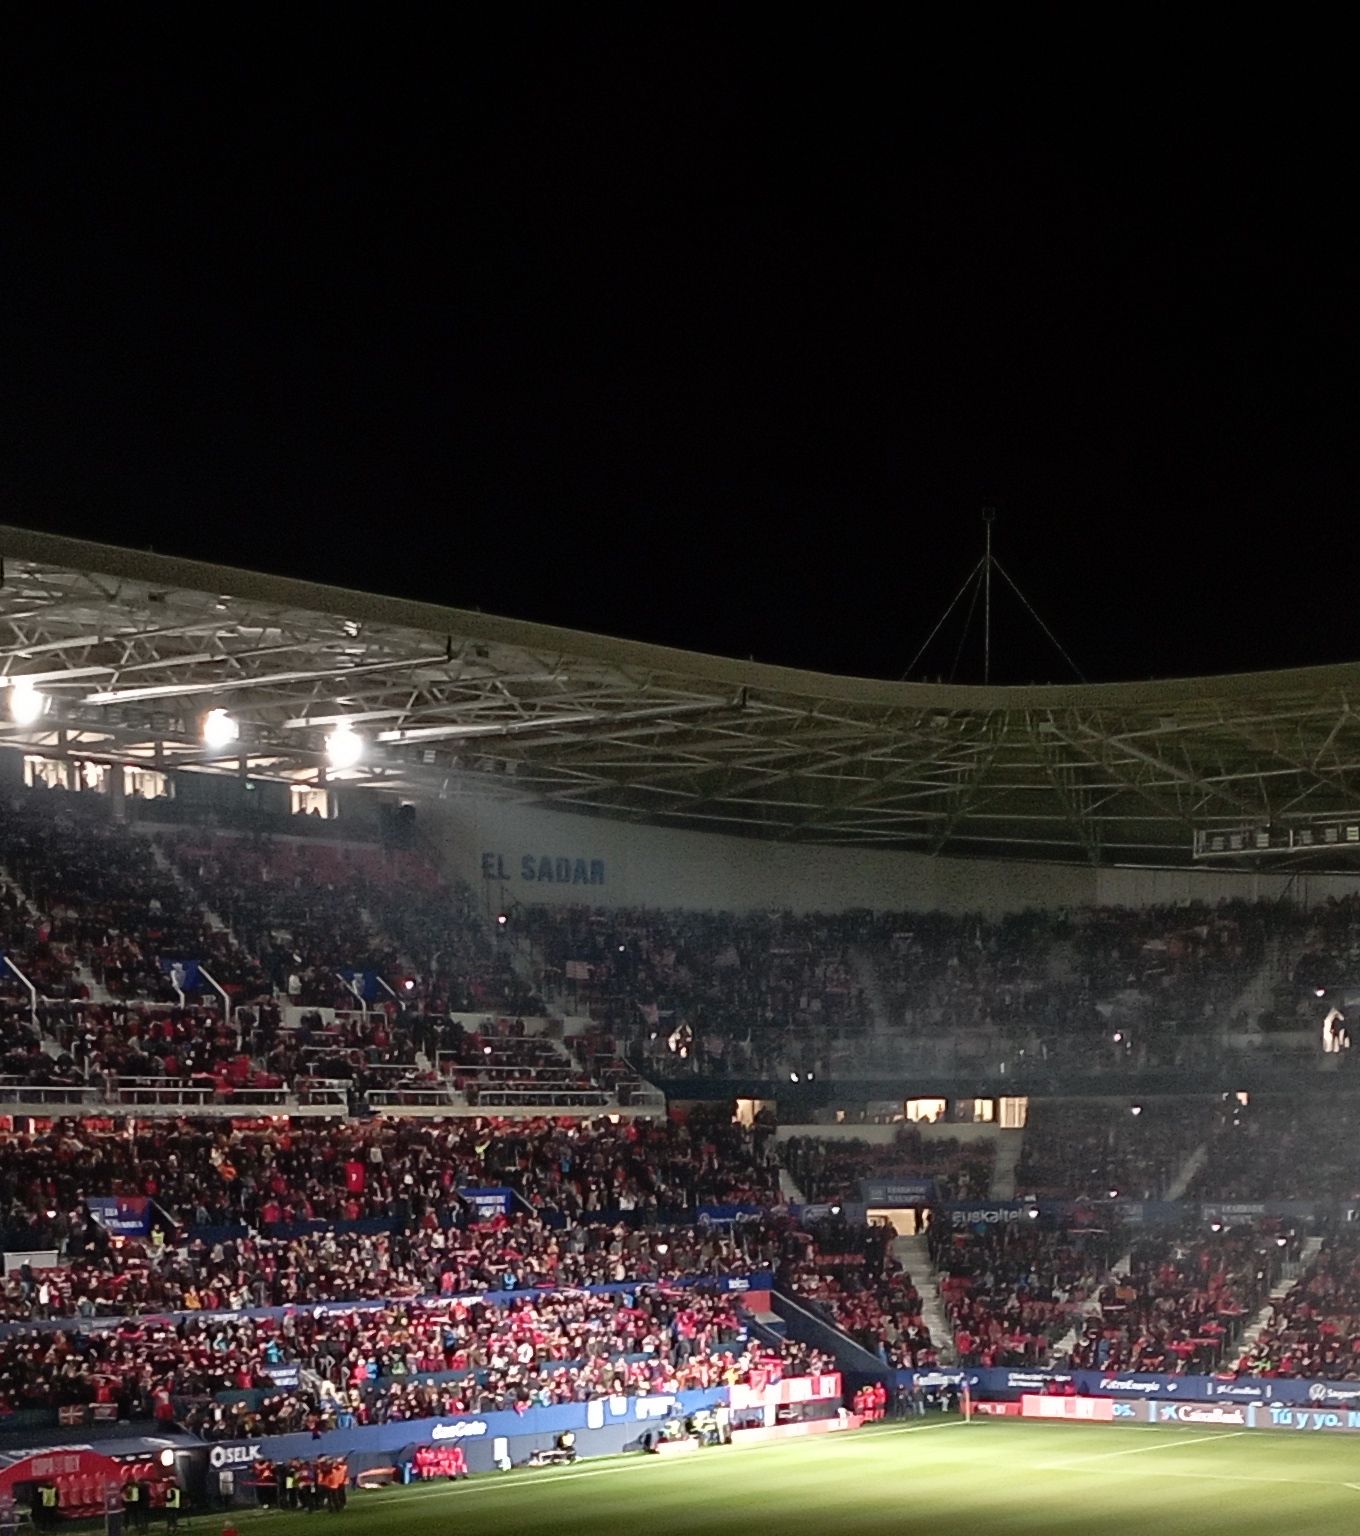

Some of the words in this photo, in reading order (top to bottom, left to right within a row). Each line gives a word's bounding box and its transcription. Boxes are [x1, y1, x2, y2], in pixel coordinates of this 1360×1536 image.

[481, 852, 511, 881] EL
[521, 853, 605, 885] SADAR
[1178, 1405, 1245, 1424] CaixaBank
[1270, 1408, 1292, 1424] Tú
[1296, 1413, 1309, 1430] y
[1313, 1413, 1343, 1430] yo.
